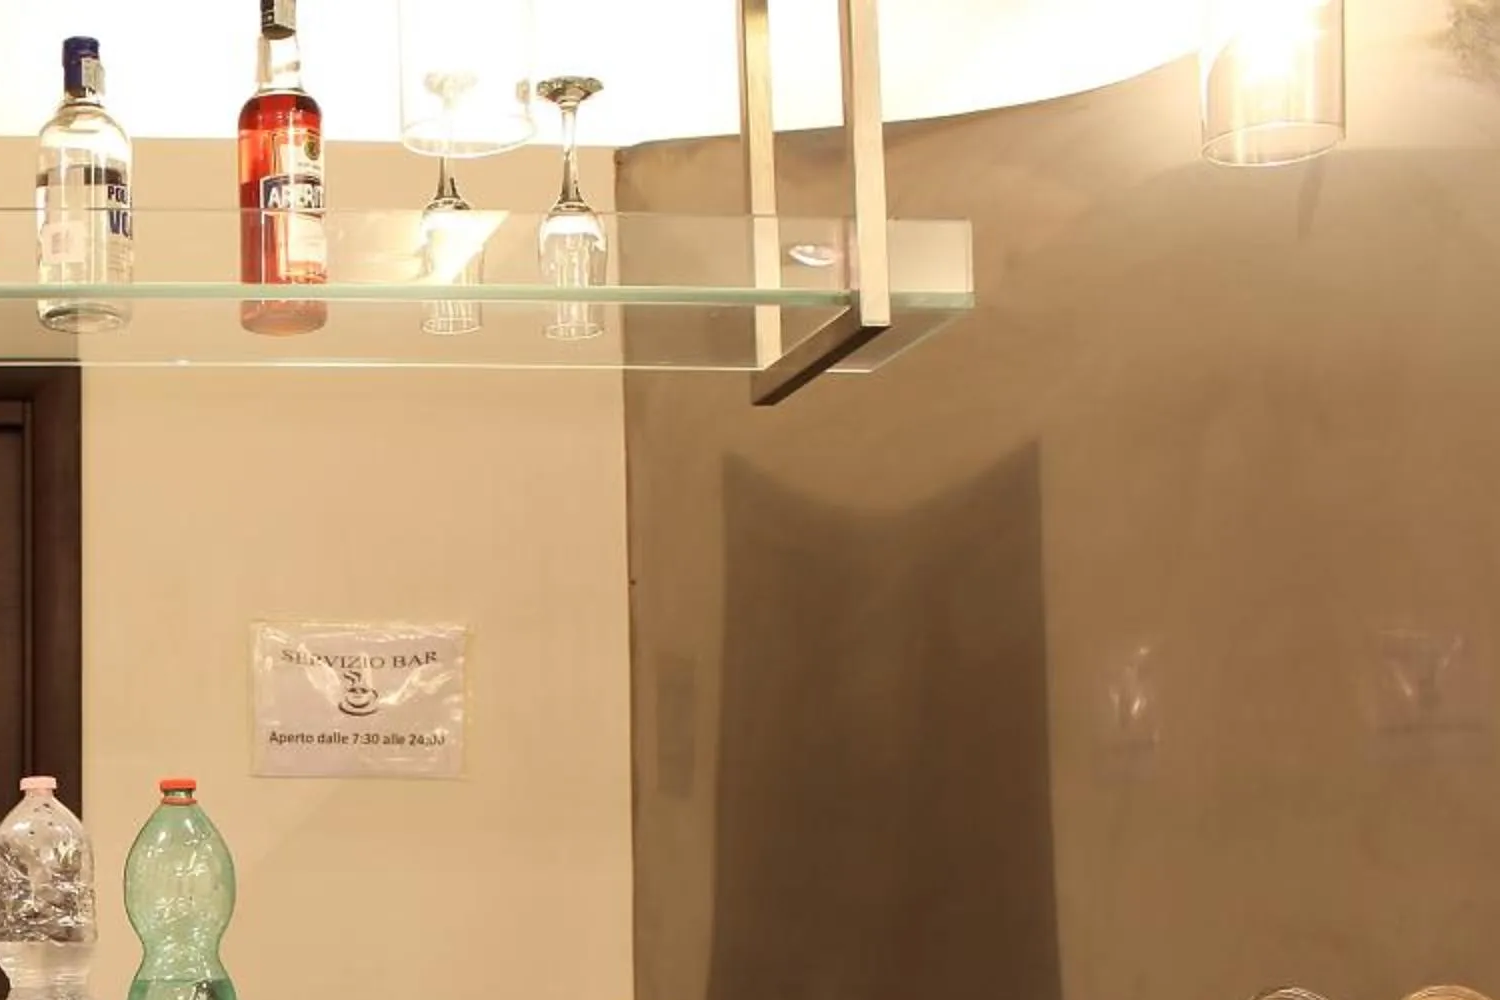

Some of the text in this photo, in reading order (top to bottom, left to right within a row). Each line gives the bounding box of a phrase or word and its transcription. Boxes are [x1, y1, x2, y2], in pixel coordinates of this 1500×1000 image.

[282, 650, 437, 669] SERVIZIO BAR
[269, 731, 314, 746] Aperto
[317, 731, 349, 744] dalle
[352, 733, 379, 745] 7:30
[383, 733, 405, 745] alle
